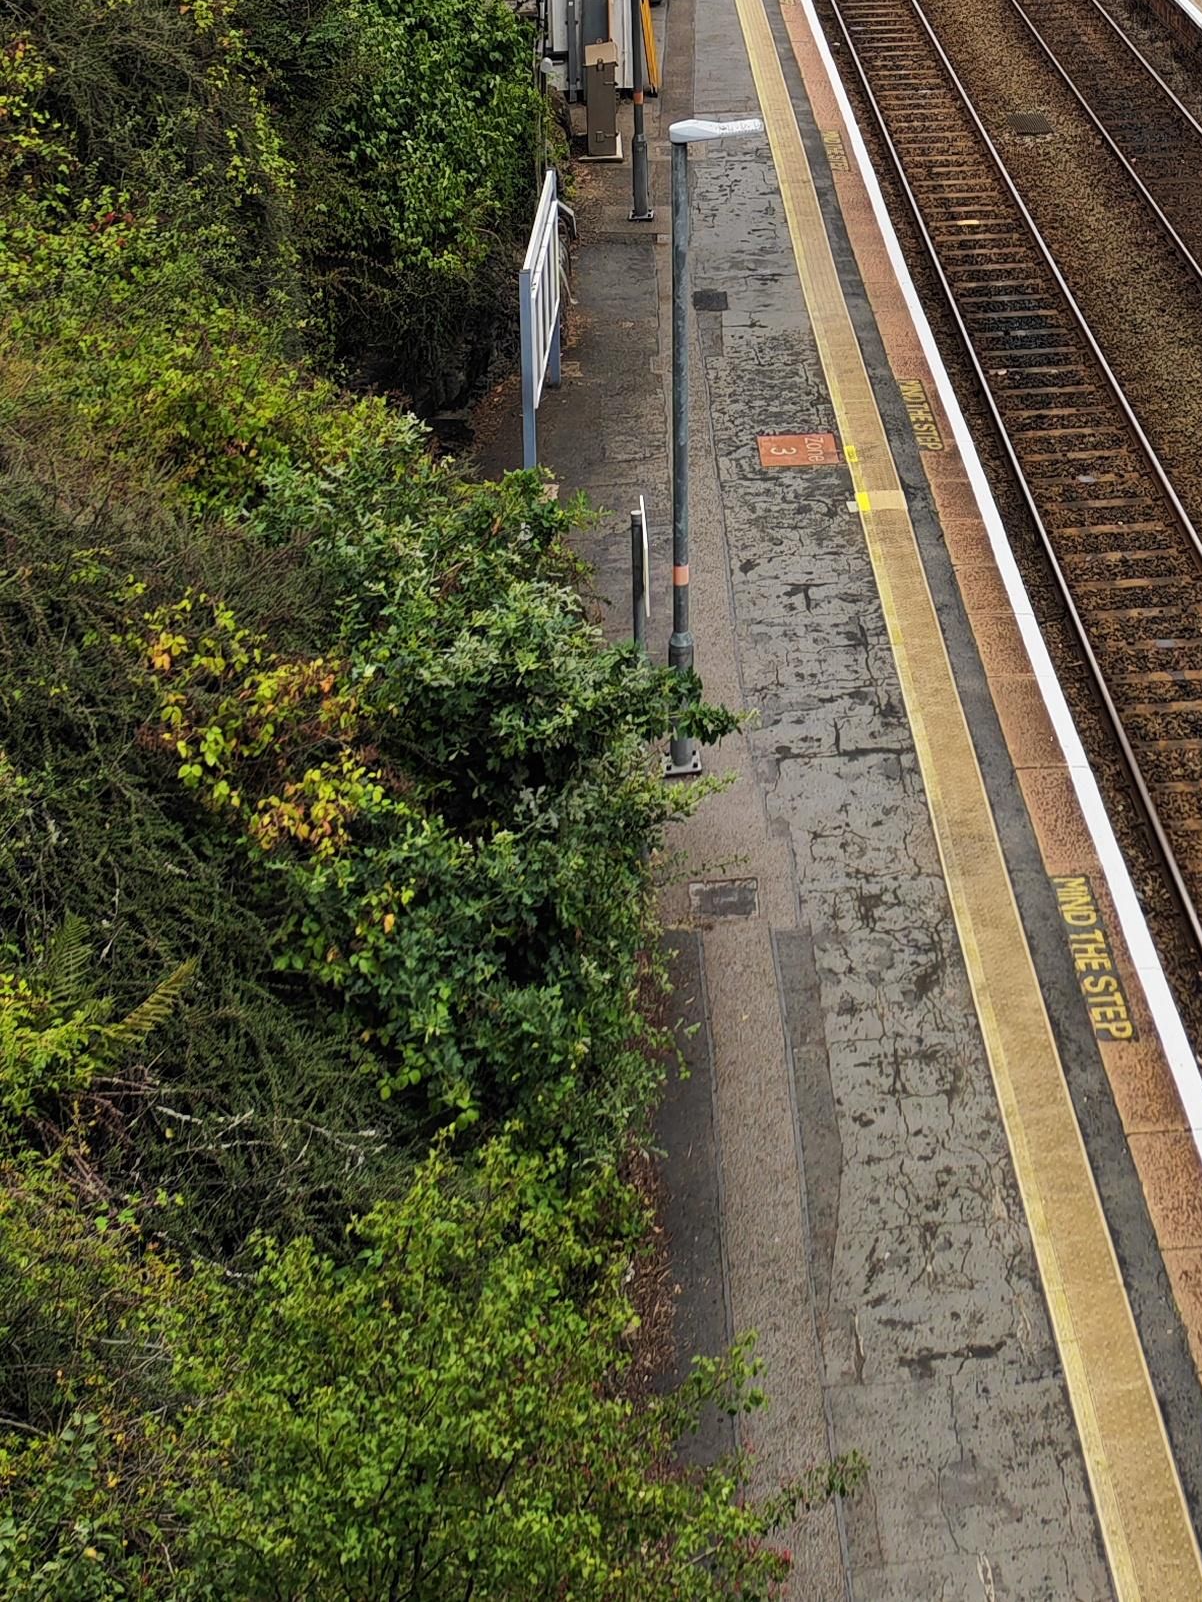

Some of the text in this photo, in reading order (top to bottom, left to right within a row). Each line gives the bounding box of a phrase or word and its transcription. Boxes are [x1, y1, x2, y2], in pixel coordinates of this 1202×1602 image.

[897, 380, 943, 451] MIND THE STEP
[770, 447, 797, 456] 3
[804, 437, 825, 462] Zone
[1053, 877, 1135, 1040] MIND THE STEP
